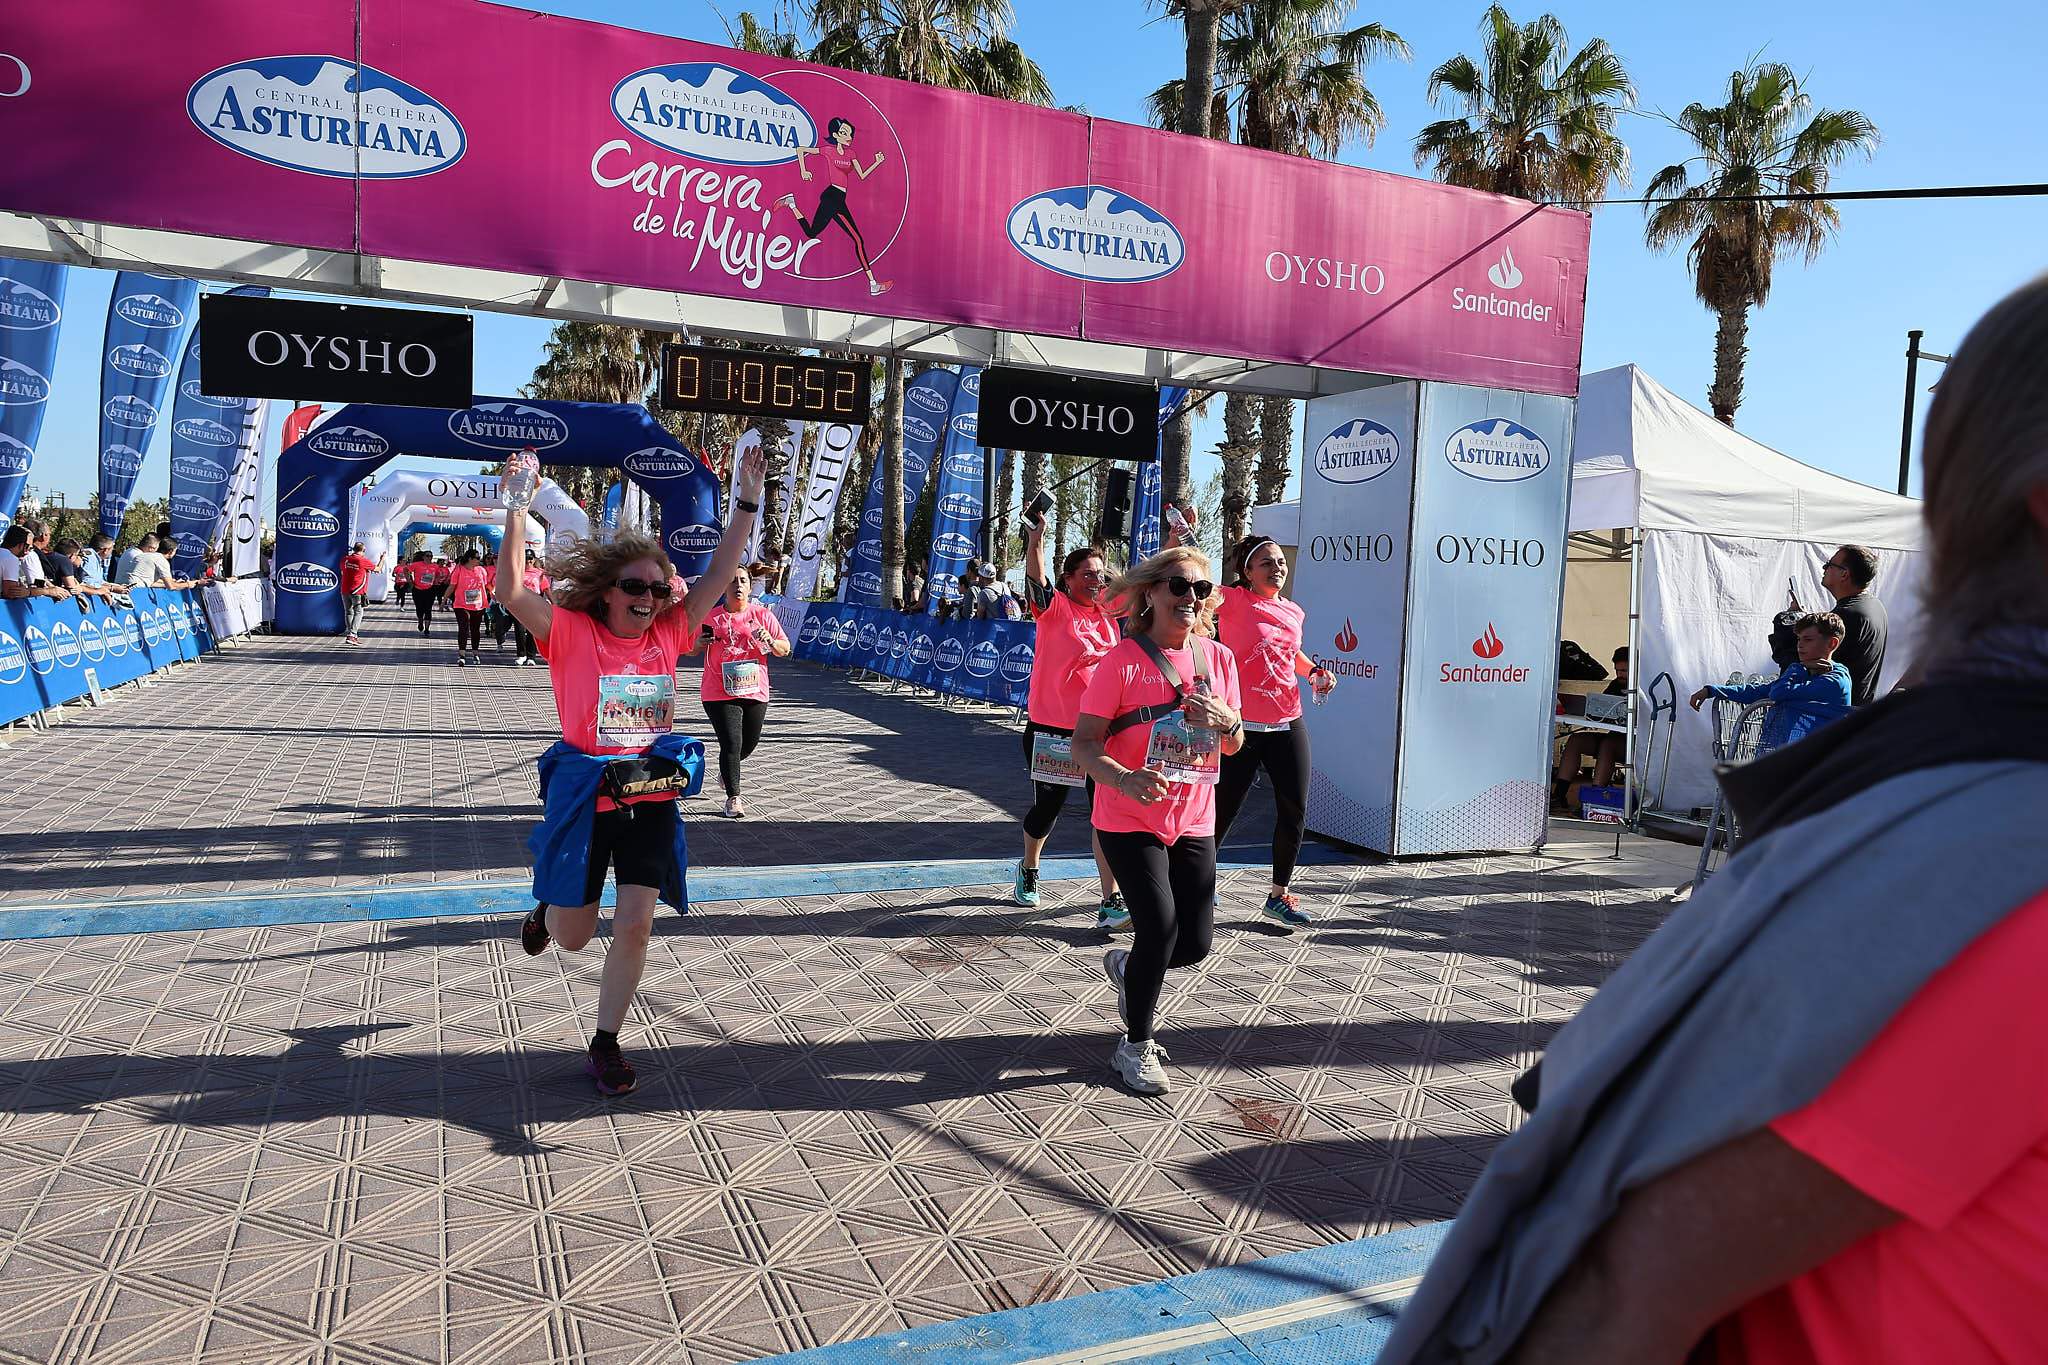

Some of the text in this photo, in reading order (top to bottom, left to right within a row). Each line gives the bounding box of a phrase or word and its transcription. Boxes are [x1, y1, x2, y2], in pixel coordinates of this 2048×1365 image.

[255, 87, 343, 111] CENTRAL
[661, 88, 797, 121] CENTRAL LECHERA
[209, 85, 447, 158] ASTURIANA
[627, 86, 801, 149] ASTURIANA
[591, 139, 769, 212] Carrera
[1020, 210, 1172, 266] ASTURIANA
[1050, 212, 1168, 238] CENTRAL LECHERA
[633, 198, 823, 290] de la Mujer
[1265, 251, 1385, 295] OYSHO
[1451, 287, 1552, 322] Santander
[247, 330, 437, 378] OYSHO
[677, 355, 856, 412] 01:06:52
[457, 414, 560, 441] ASTURIANA
[1010, 396, 1134, 434] OYSHO
[313, 436, 383, 453] ASTURIANA
[1319, 445, 1393, 471] ASTURIANA
[1451, 437, 1542, 470] ASTURIANA
[630, 457, 691, 471] ASTURIANA
[369, 496, 400, 504] OYSHO
[428, 479, 498, 500] OYSH
[797, 422, 853, 562] OYSHO
[281, 519, 336, 532] ASTURIANA
[1311, 534, 1393, 563] OYSHO
[1436, 534, 1545, 568] OYSHO
[279, 574, 334, 588] ASTURIANA
[1439, 663, 1530, 683] Santander
